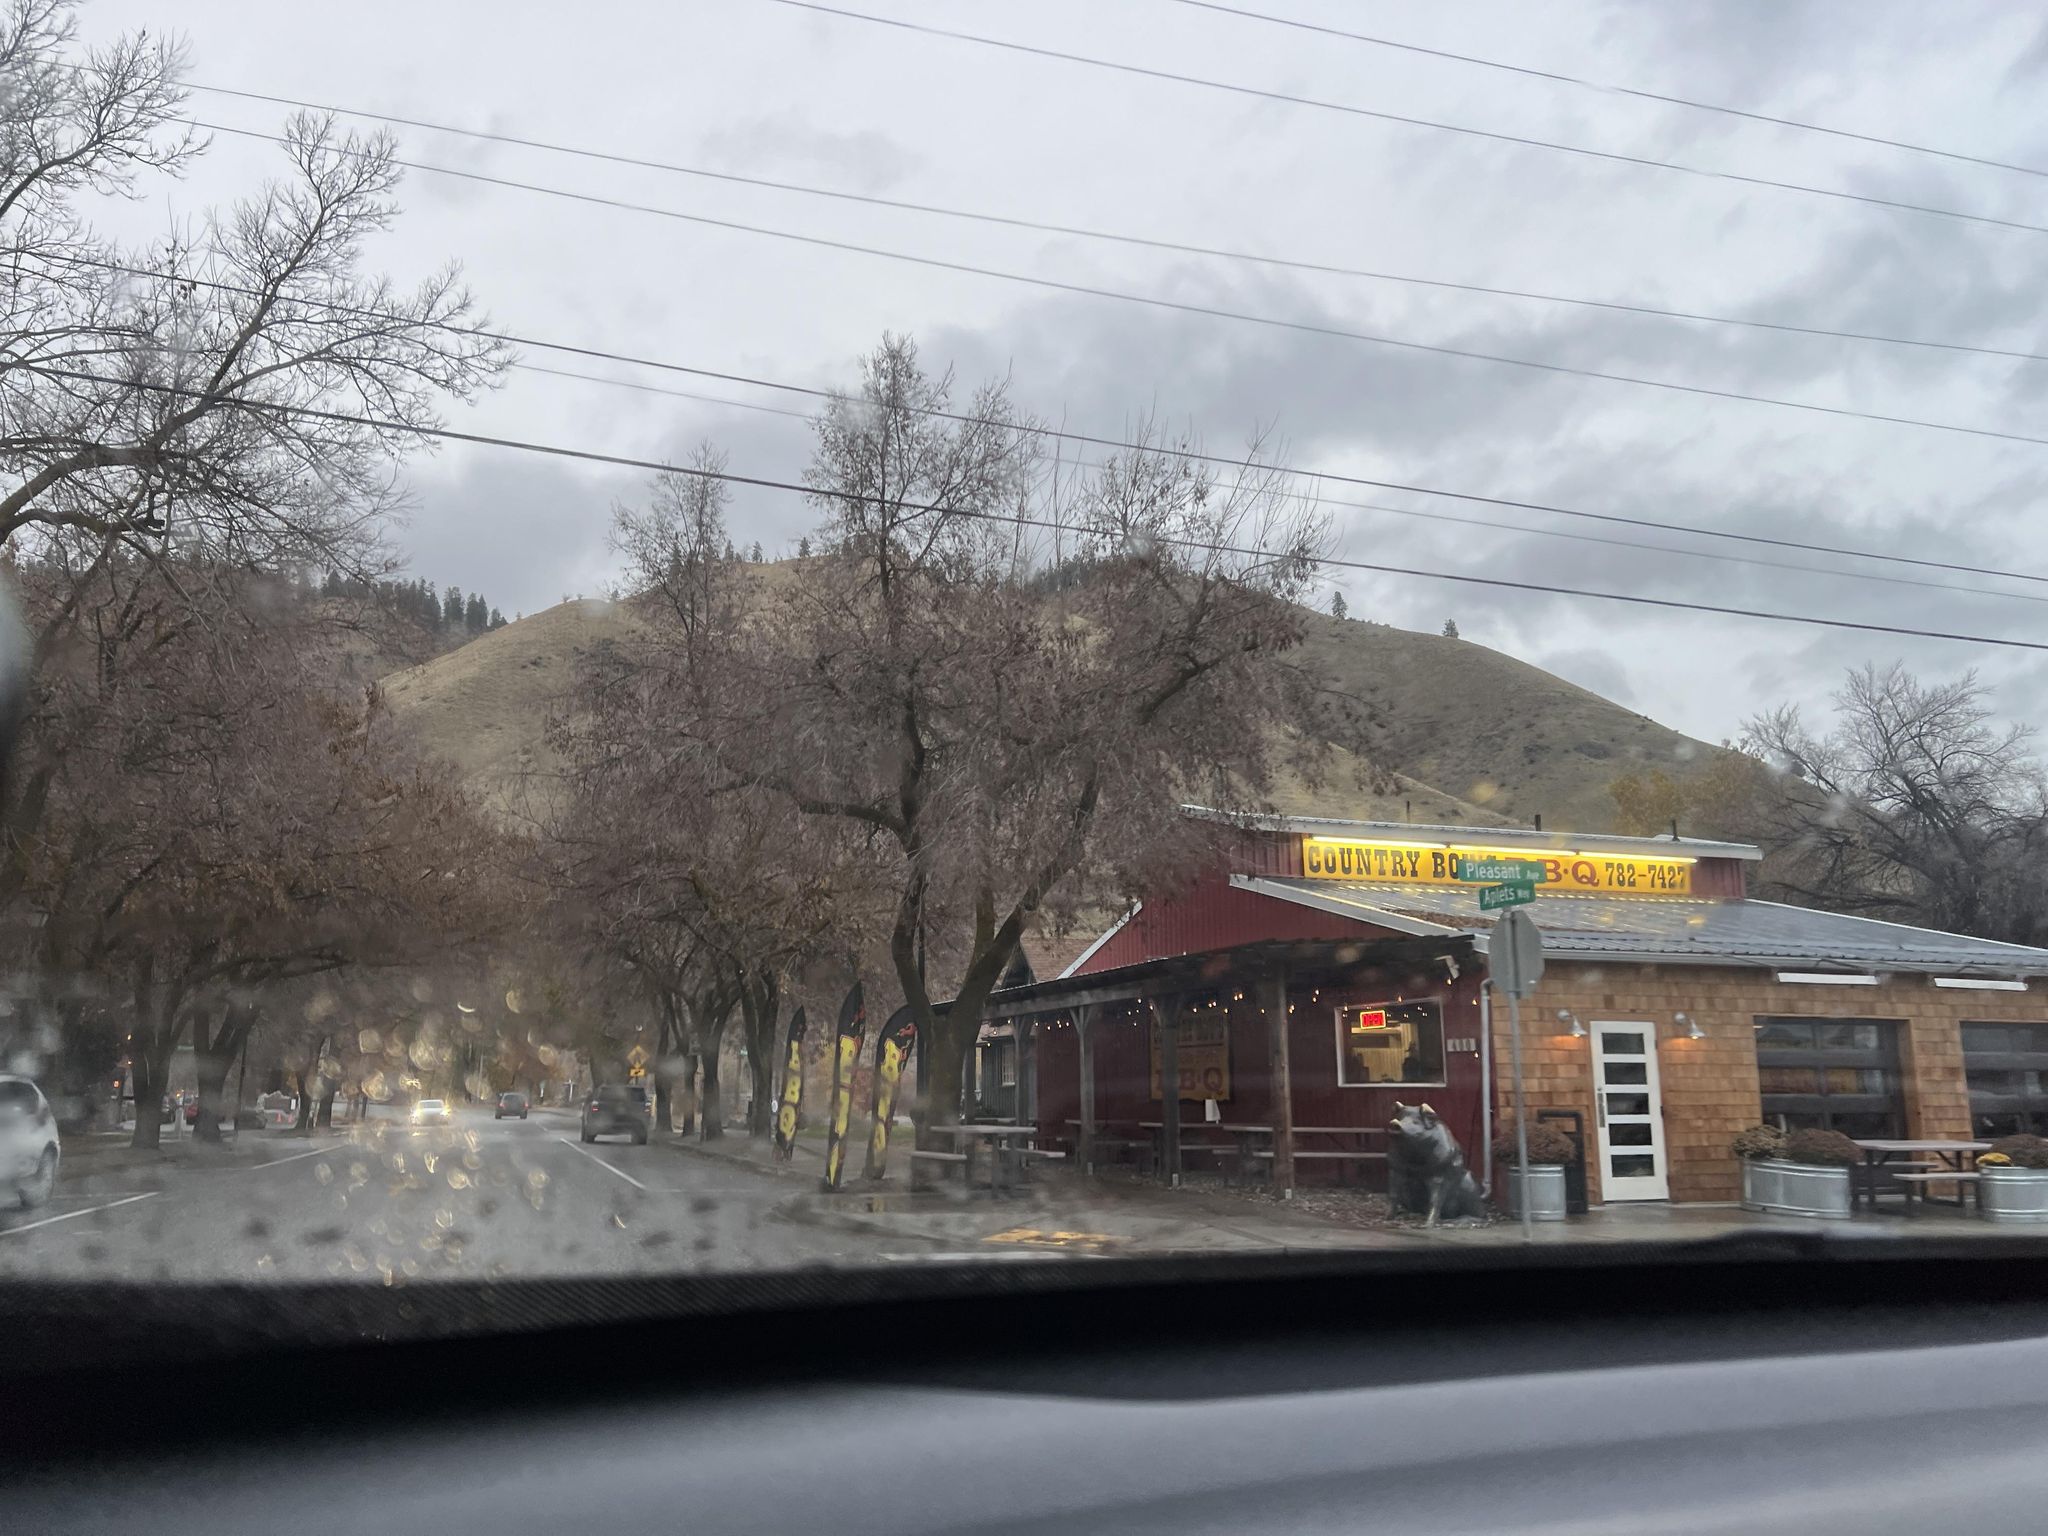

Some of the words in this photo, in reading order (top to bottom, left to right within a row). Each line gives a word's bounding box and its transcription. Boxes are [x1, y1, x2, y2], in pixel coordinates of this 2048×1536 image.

[1308, 845, 1421, 878] COUNTRY
[1605, 862, 1686, 890] 782-7427
[1465, 862, 1521, 880] Pleasant
[1484, 886, 1516, 907] Aplets
[1362, 1013, 1383, 1027] OPEN
